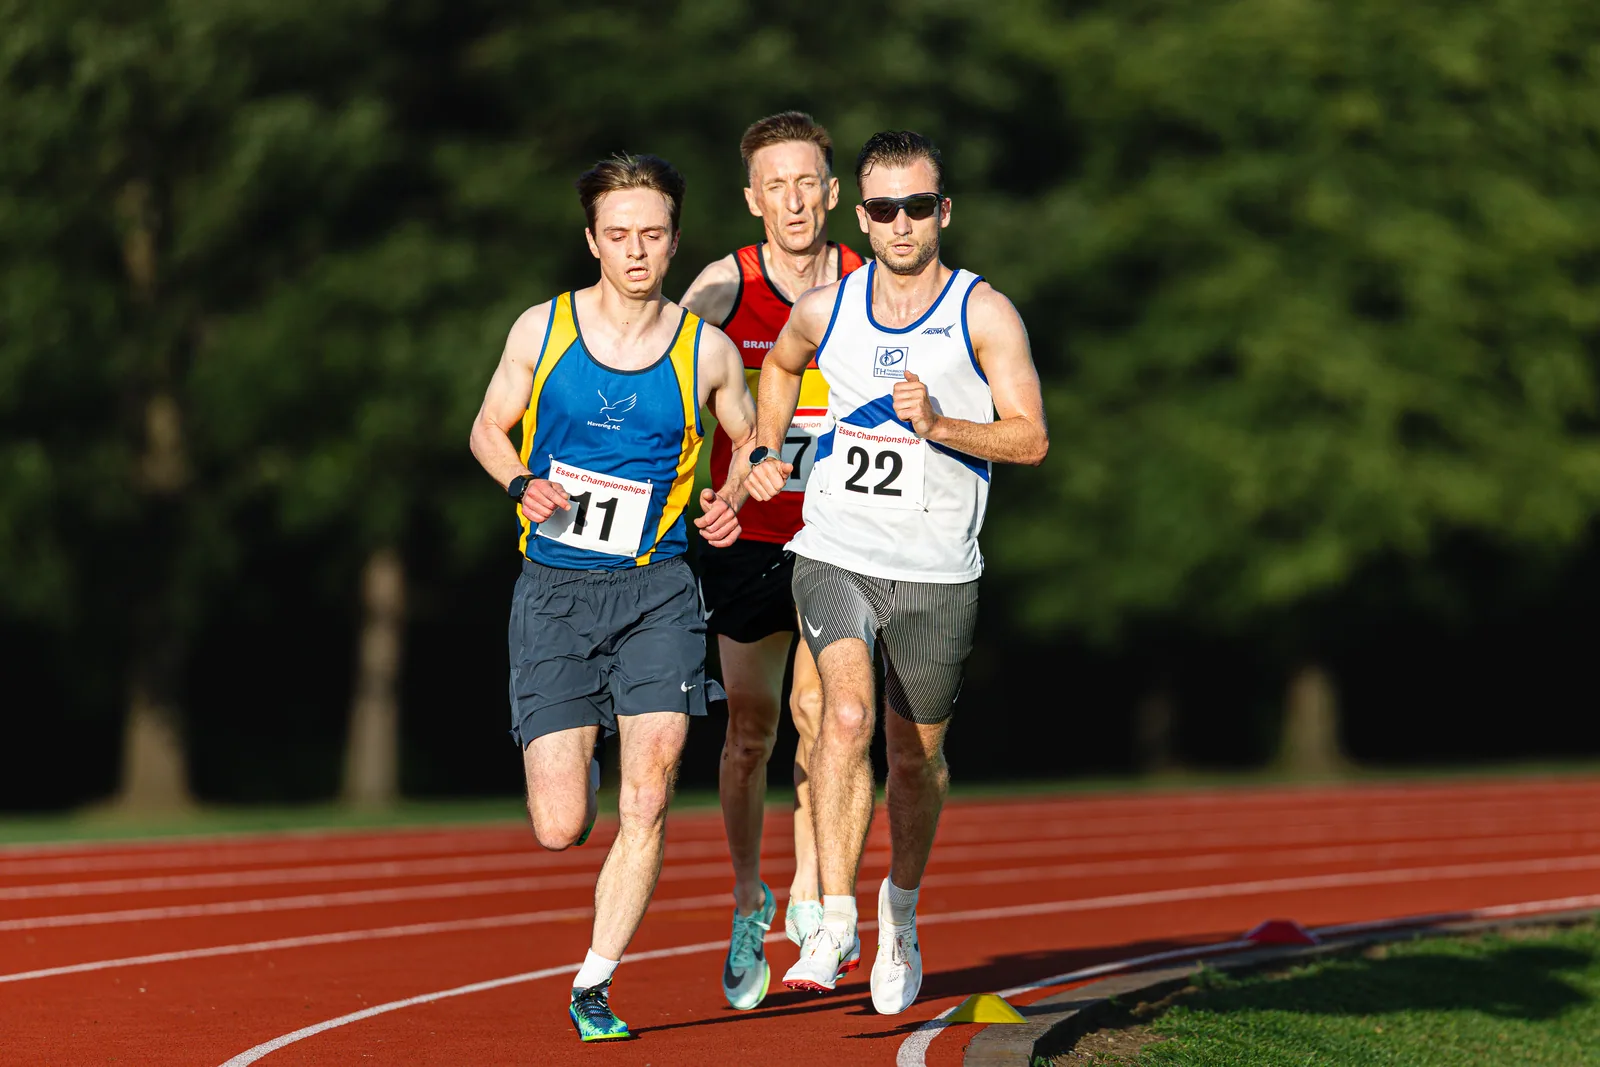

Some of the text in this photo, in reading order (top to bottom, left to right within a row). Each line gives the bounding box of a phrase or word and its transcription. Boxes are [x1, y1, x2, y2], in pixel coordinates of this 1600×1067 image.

[838, 426, 920, 446] Essex Championships
[555, 466, 647, 495] Essex Championships
[845, 445, 903, 497] 22
[569, 490, 619, 542] 11
